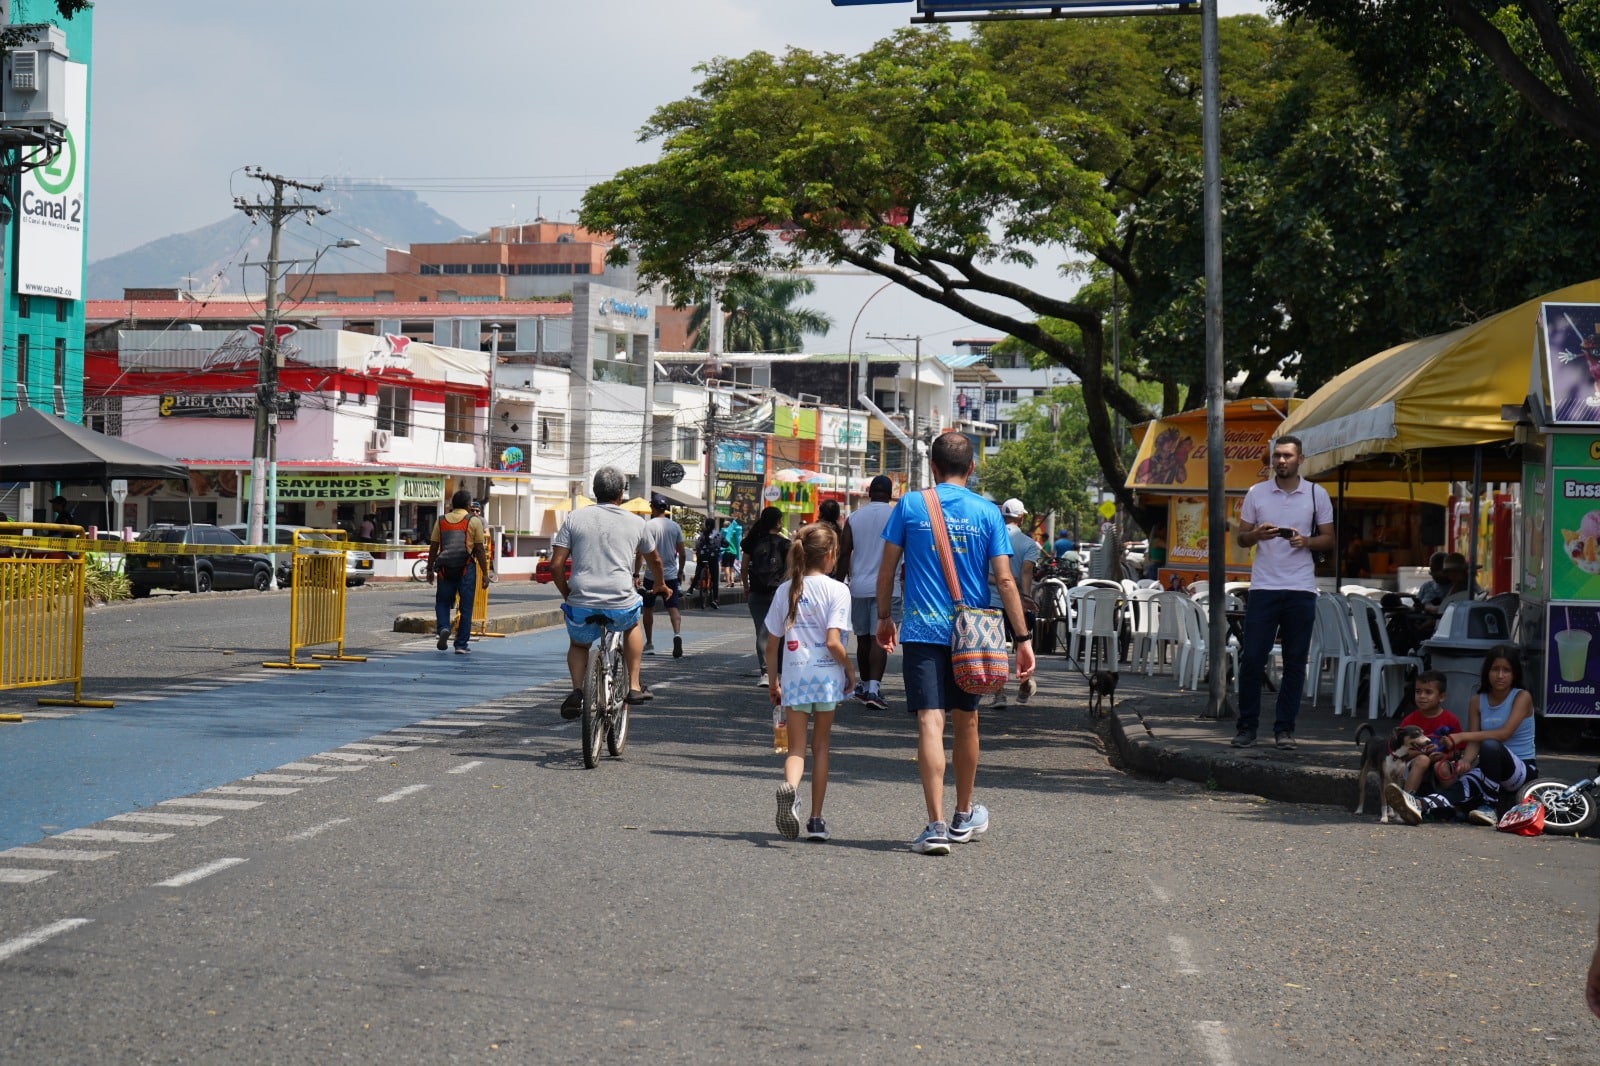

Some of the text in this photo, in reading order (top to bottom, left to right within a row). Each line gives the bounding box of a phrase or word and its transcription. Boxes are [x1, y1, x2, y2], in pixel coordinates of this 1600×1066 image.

[22, 189, 82, 223] Canal 2
[25, 283, 72, 296] www.canal2.co
[176, 395, 210, 407] PIEL
[377, 478, 390, 487] Y
[403, 480, 441, 499] ALMUERZOS
[1554, 684, 1596, 694] Limonada
